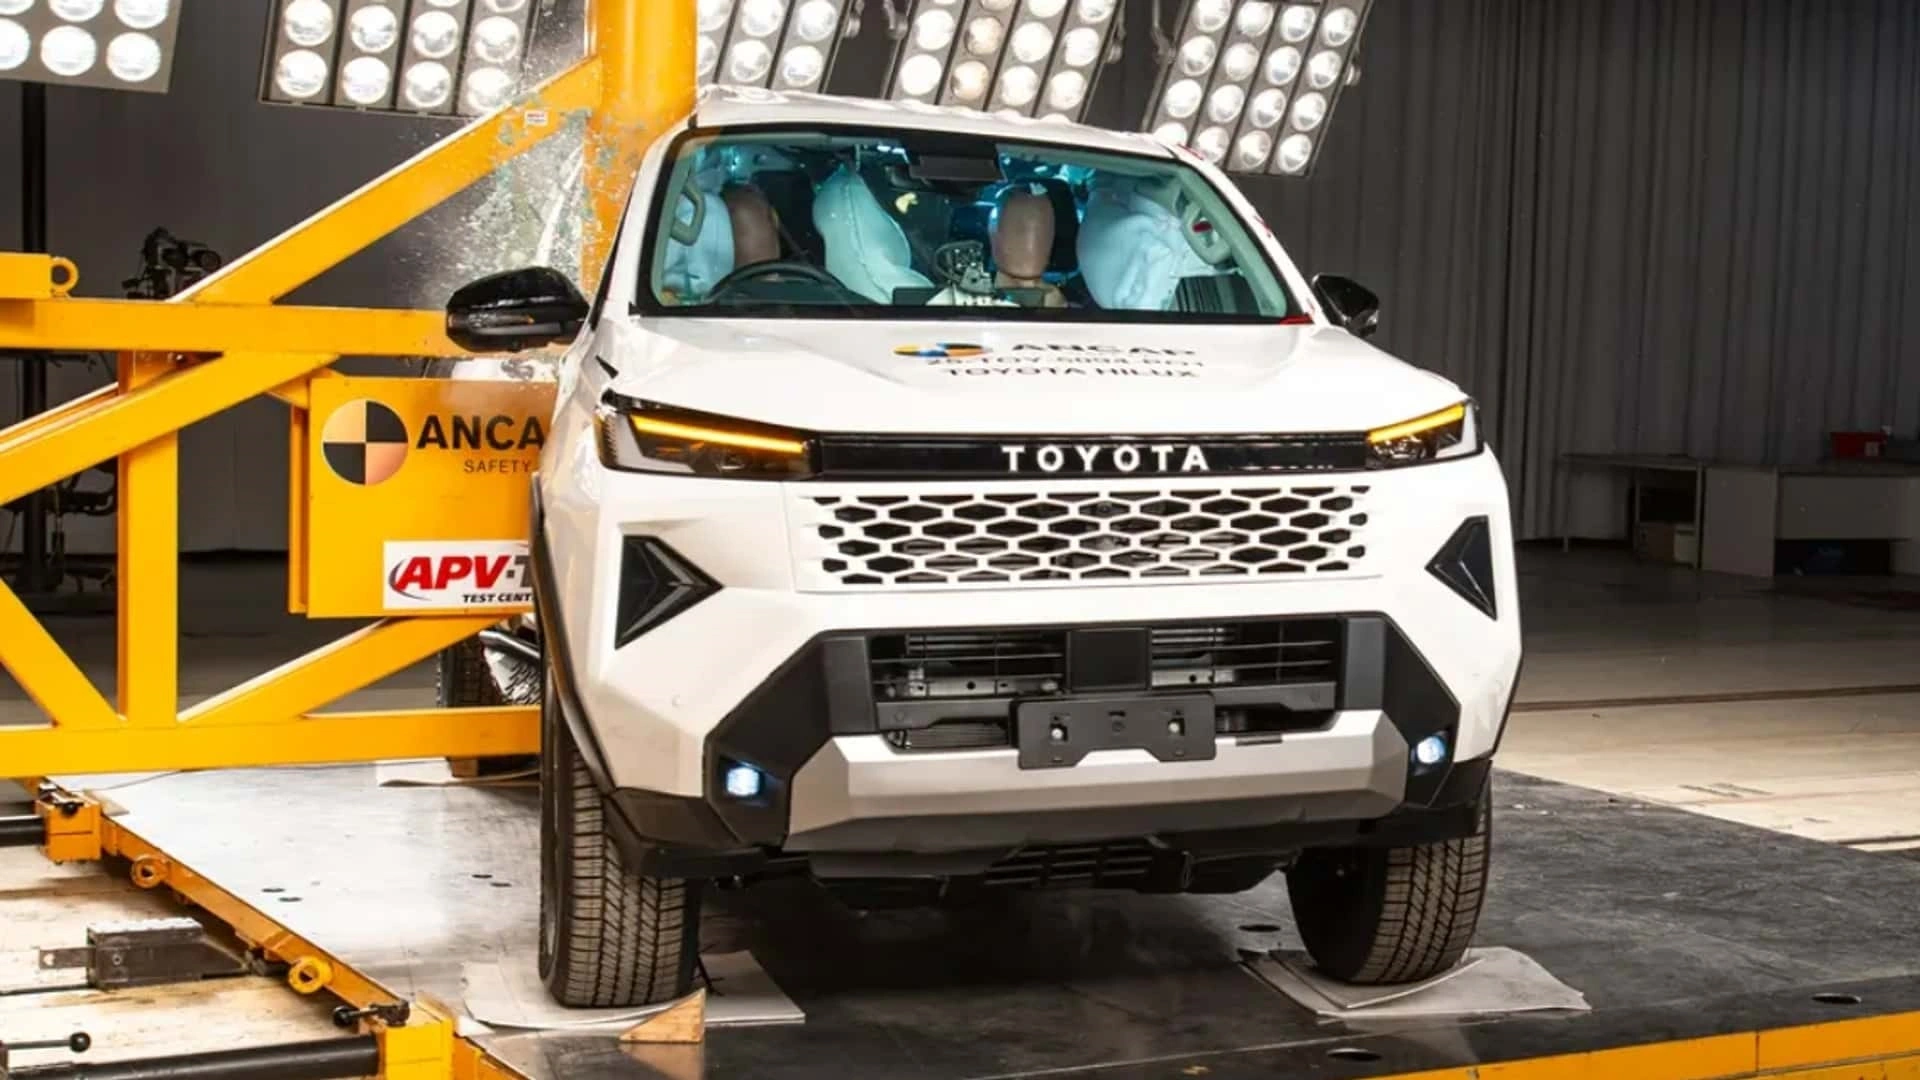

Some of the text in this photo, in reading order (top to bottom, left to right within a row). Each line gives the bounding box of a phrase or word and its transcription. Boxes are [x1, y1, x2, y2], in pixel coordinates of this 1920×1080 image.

[945, 367, 1198, 378] TOYOTA HILUX
[416, 414, 545, 451] ANCA
[1002, 445, 1209, 472] TOYOTA
[463, 459, 532, 473] SAFETY
[463, 593, 533, 603] TEST CENT
